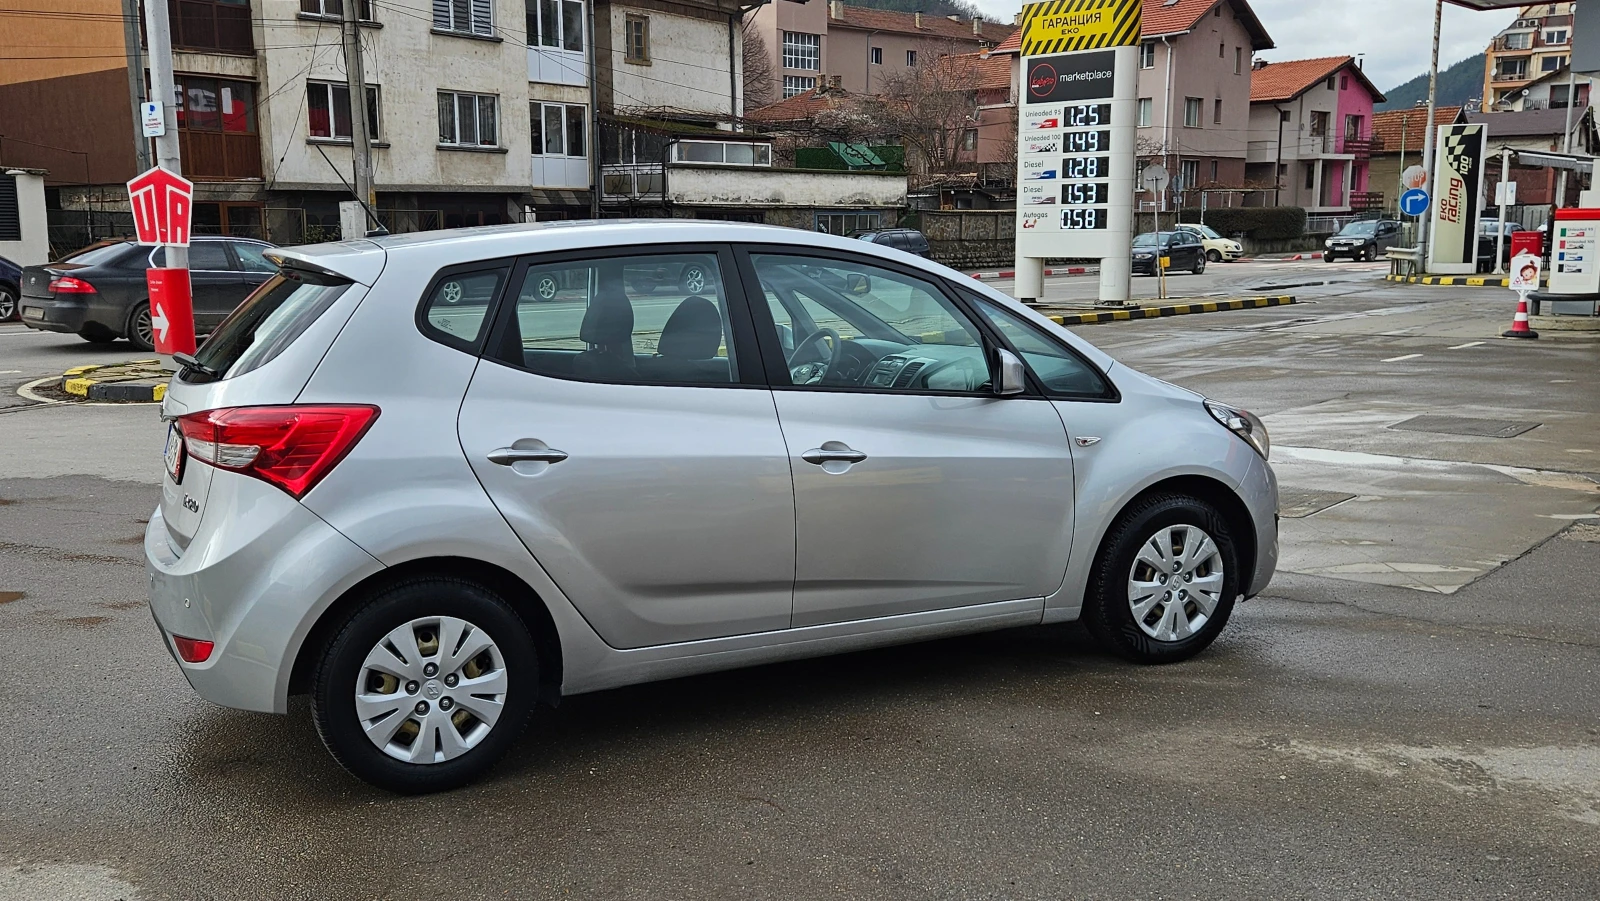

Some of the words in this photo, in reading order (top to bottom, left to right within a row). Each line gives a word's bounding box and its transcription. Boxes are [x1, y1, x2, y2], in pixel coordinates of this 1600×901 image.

[1042, 13, 1101, 29] ГАРАНЦИЯ
[1060, 70, 1112, 82] marketplace
[1025, 110, 1053, 118] Unleaded
[1071, 105, 1099, 126] 1.25
[1024, 134, 1051, 142] Unleaded
[1069, 131, 1098, 152] 1.49
[1024, 160, 1044, 168] Diesel
[1068, 157, 1097, 178] 1.28
[1460, 155, 1469, 175] 100
[1023, 185, 1043, 193] Diesel
[1068, 183, 1097, 204] 1.53
[1440, 198, 1448, 221] EKO
[1447, 177, 1463, 223] racing
[1023, 211, 1048, 219] Autogas
[1061, 209, 1096, 229] 0.58
